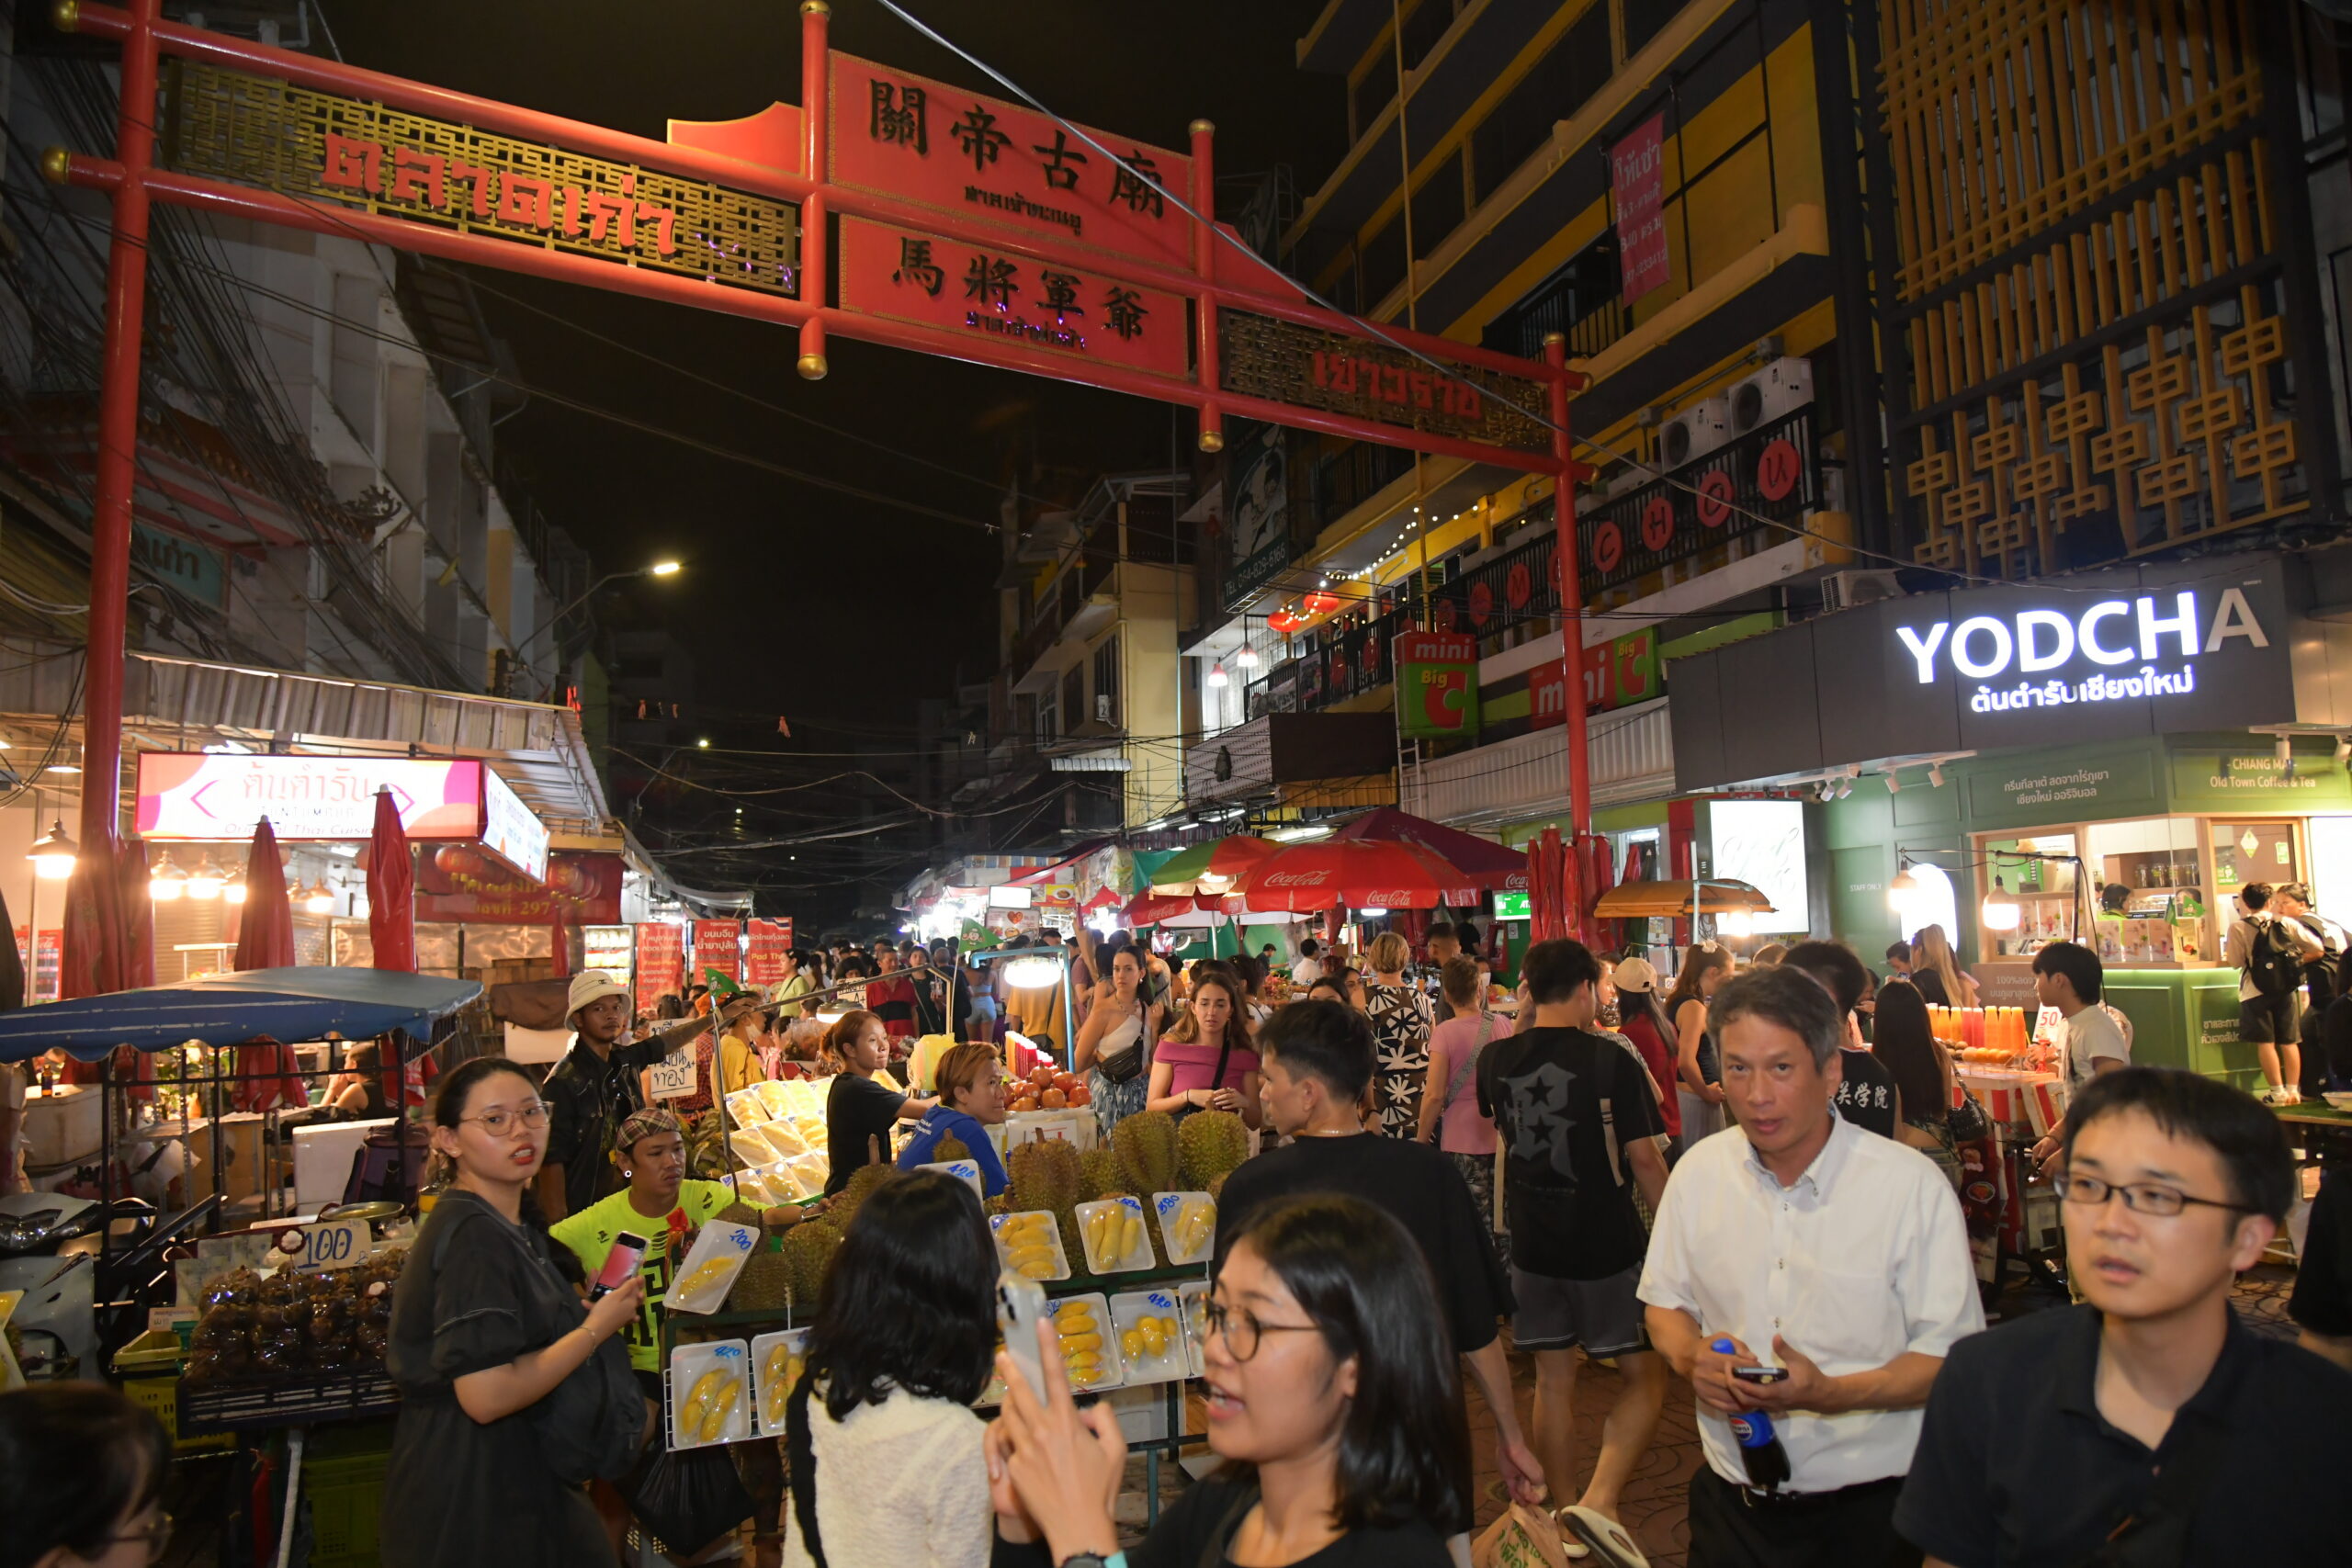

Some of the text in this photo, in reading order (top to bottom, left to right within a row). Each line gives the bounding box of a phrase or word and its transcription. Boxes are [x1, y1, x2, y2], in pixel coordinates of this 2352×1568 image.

[321, 132, 676, 256] ตลาดเก่า
[1314, 350, 1482, 420] เยาวราช
[1895, 588, 2269, 684] YODCHA
[1415, 637, 1471, 660] mini
[1618, 640, 1636, 659] Big
[1420, 670, 1449, 688] Big
[1537, 649, 1606, 716] mni
[1970, 664, 2194, 713] ต้นตำรับเชียงใหม่
[2233, 759, 2270, 770] CHIANG
[2210, 776, 2228, 788] Old
[2229, 776, 2256, 788] Town
[2257, 776, 2289, 788] Coffee
[2300, 776, 2316, 787] Tea
[1264, 870, 1334, 887] Coca-Cola
[1849, 883, 1882, 892] STAFF ONLY
[1367, 890, 1413, 907] Coca-Cola
[520, 901, 550, 915] 297
[704, 929, 735, 939] ขนมจีน
[751, 953, 768, 961] Pad
[2040, 1011, 2058, 1027] 50
[653, 1067, 685, 1087] ทอง
[297, 1227, 353, 1269] 100
